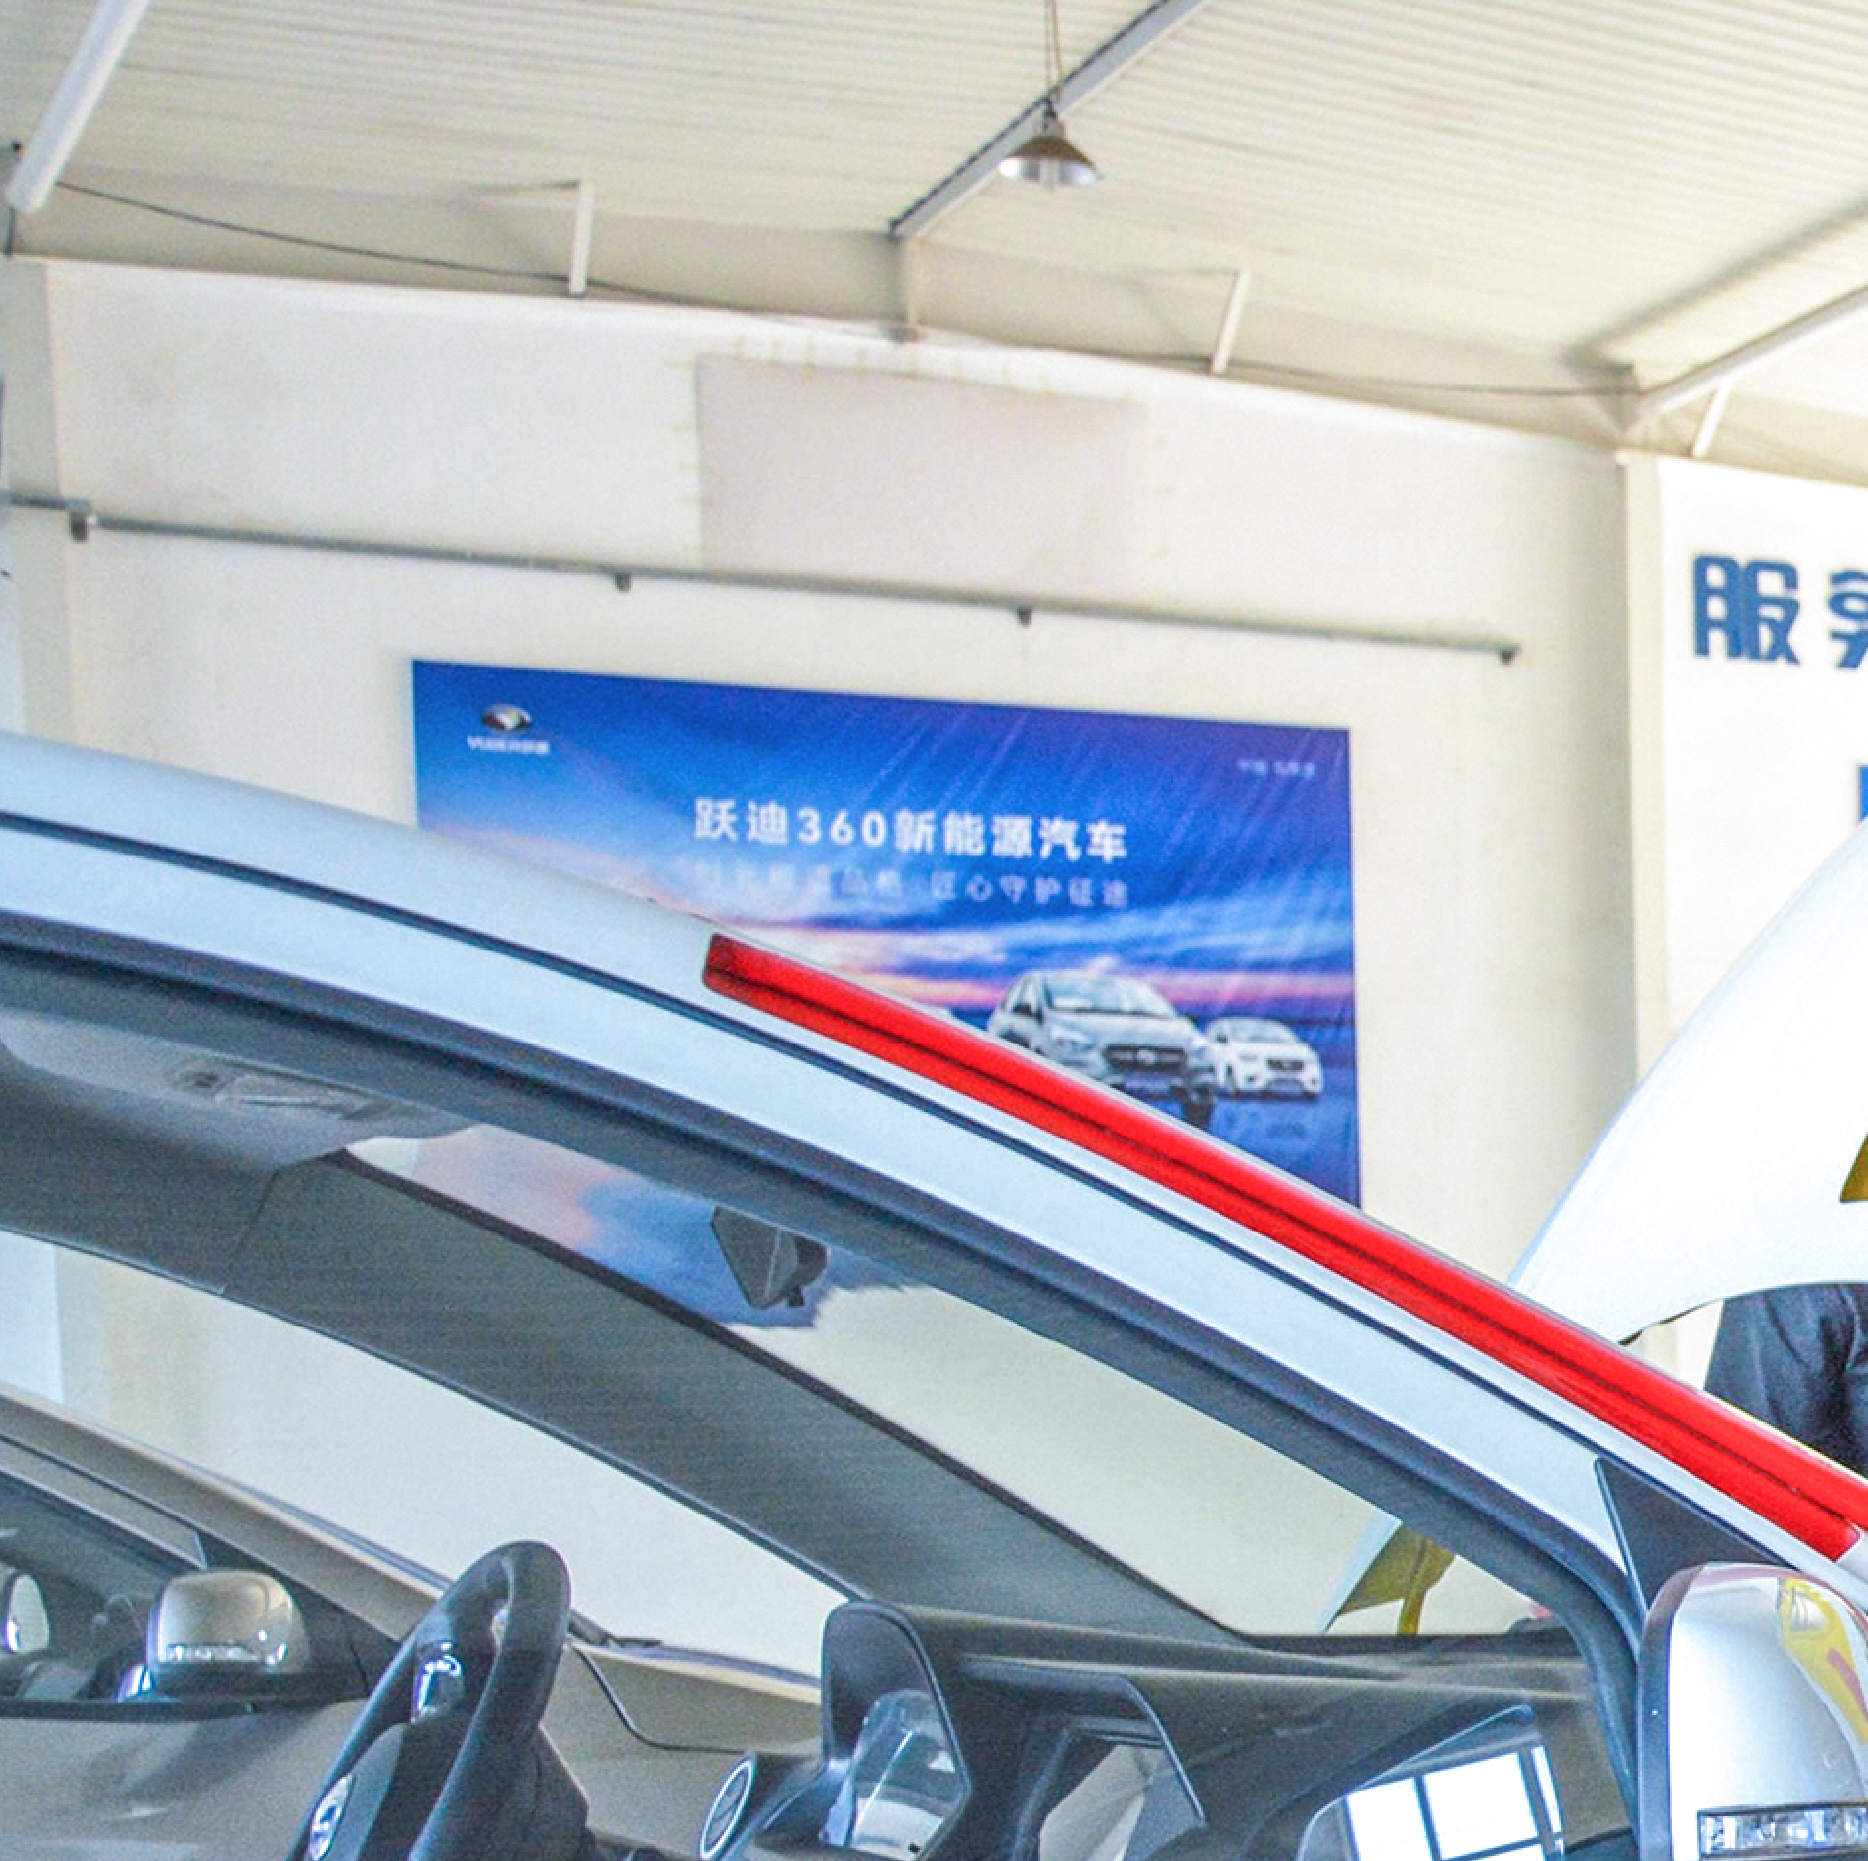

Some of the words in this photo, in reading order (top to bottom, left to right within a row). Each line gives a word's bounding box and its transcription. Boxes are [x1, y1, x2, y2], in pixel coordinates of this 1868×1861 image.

[694, 796, 1129, 864] 跃迪360新能源汽车
